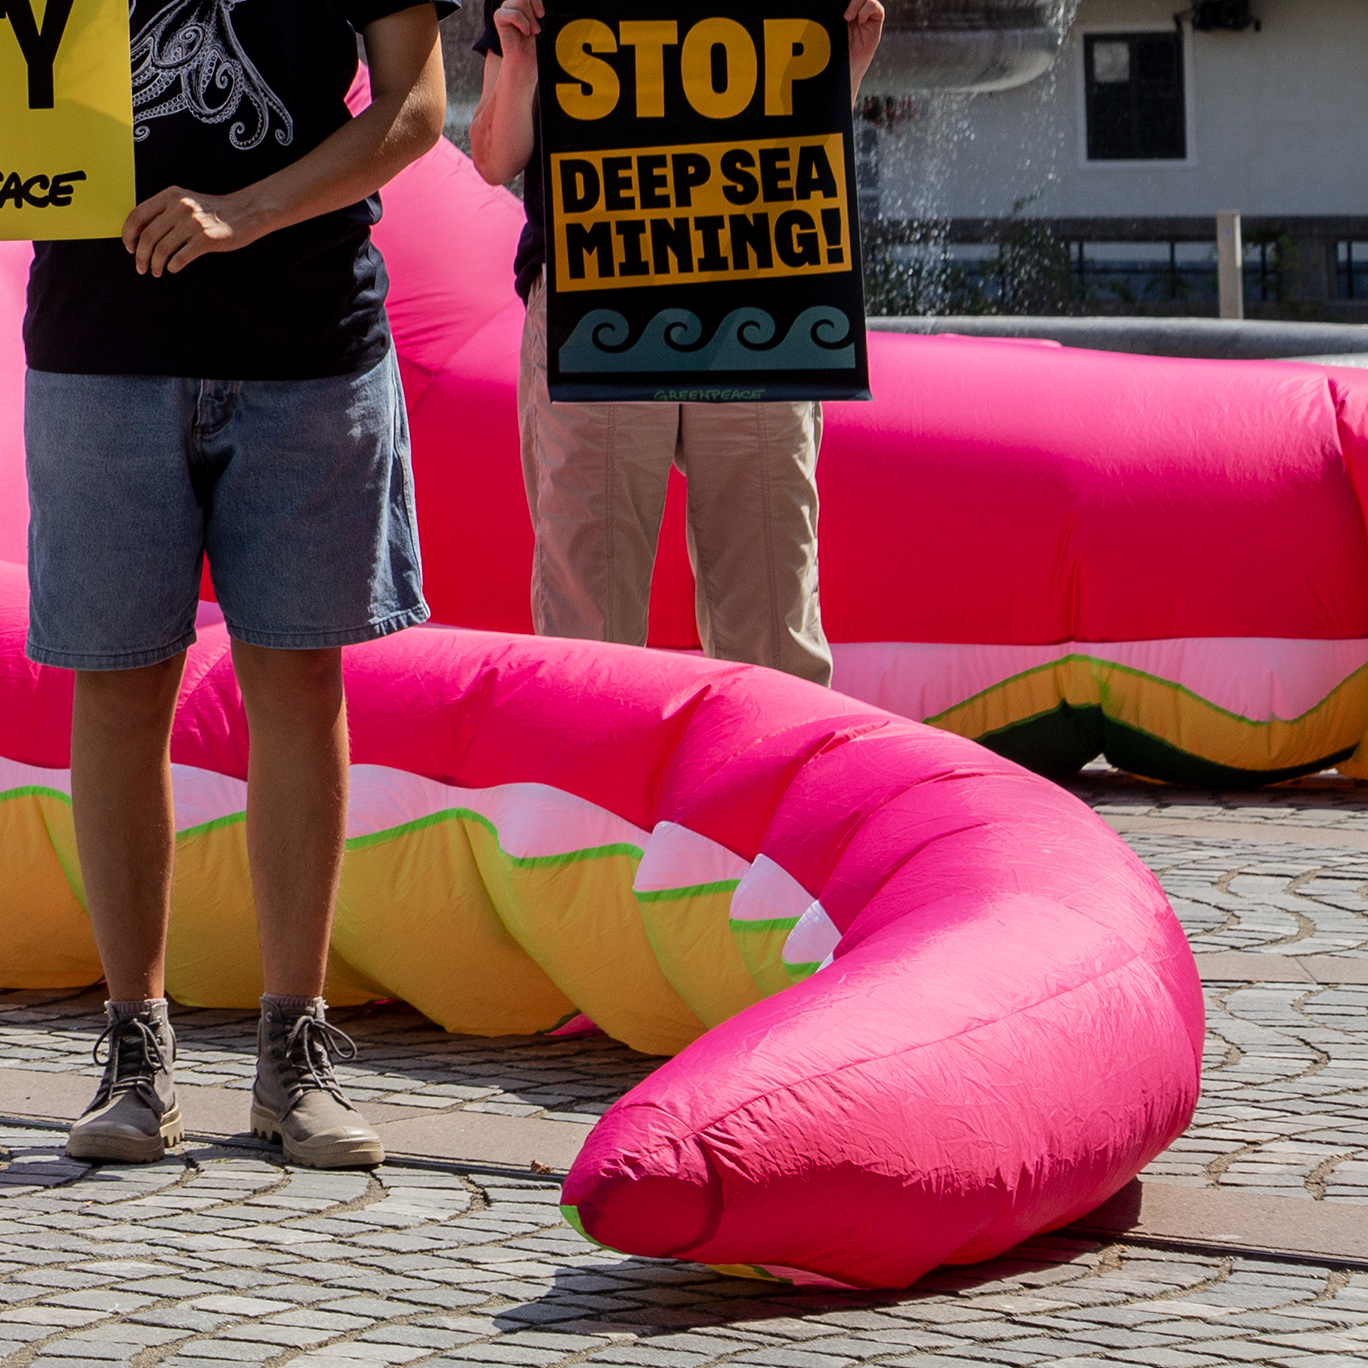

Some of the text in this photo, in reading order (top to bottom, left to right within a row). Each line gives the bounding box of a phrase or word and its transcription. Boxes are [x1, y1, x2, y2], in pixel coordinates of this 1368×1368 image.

[555, 16, 832, 121] STOP
[559, 144, 838, 214] DEEP SEA
[565, 207, 845, 280] MINING!
[653, 389, 765, 401] GREENPEACE
